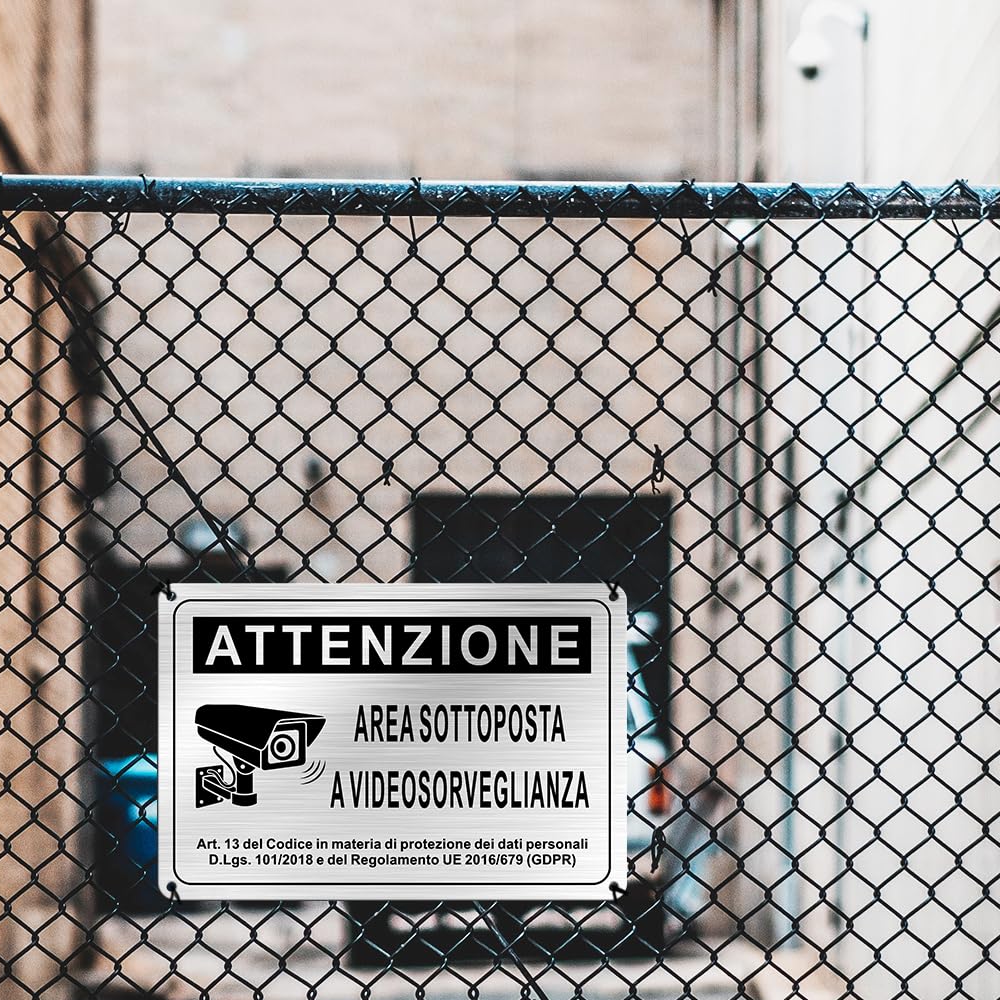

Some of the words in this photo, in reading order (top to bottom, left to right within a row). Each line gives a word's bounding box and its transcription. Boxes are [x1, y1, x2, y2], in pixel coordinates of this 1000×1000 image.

[204, 624, 580, 666] ATTENZIONE
[353, 704, 415, 743] AREA
[419, 703, 566, 743] SOTTOPOSTA
[330, 770, 345, 809] A
[349, 770, 590, 809] VIDEOSORVEGLIANZA
[196, 838, 221, 850] Art.
[224, 838, 240, 850] 13
[242, 838, 263, 850] del
[266, 837, 313, 850] Codice
[316, 838, 328, 850] in
[331, 838, 382, 850] materia
[384, 838, 397, 850] di
[400, 838, 472, 852] protezione
[474, 838, 495, 850] dei
[497, 838, 523, 850] dati
[526, 838, 588, 852] personali
[209, 853, 252, 868] D.Lgs.
[255, 853, 314, 866] 101/2018
[316, 856, 325, 866] e
[327, 853, 348, 866] del
[351, 853, 440, 868] Regolamento
[442, 853, 462, 866] UE
[464, 853, 524, 866] 2016/679
[526, 853, 576, 868] (GDPR)
